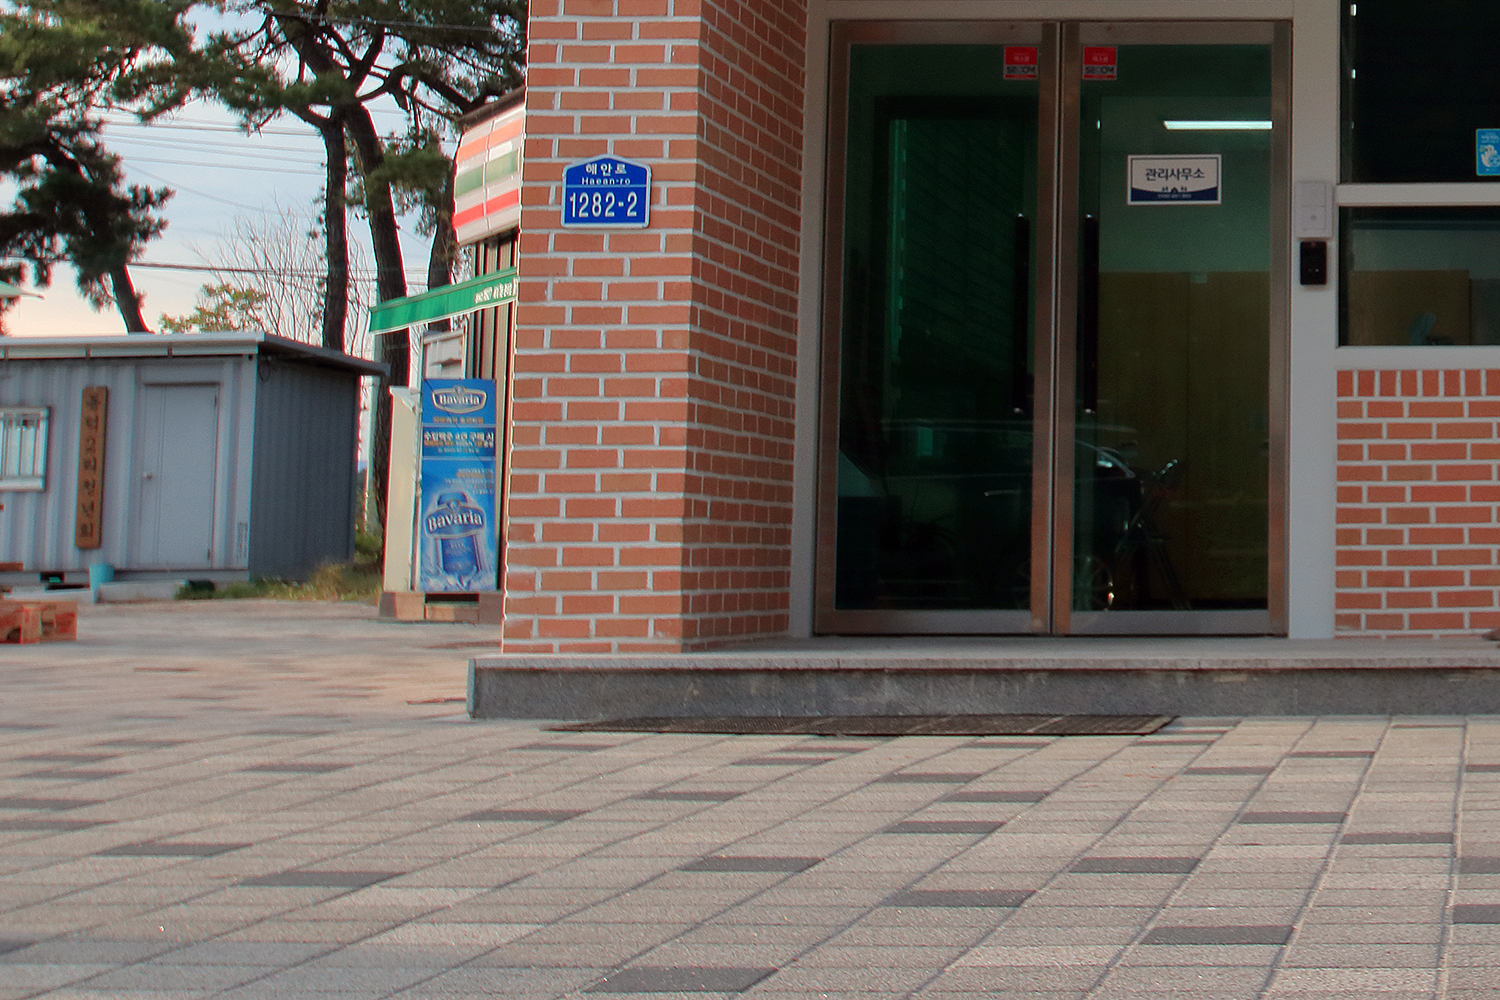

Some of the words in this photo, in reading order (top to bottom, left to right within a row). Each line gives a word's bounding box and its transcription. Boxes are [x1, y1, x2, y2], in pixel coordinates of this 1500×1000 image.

[585, 163, 626, 176] 해안로
[1146, 168, 1204, 181] 관리사무소
[581, 177, 631, 185] Haean-ro
[570, 192, 637, 217] 1282-2
[439, 394, 480, 405] Bavaria
[428, 510, 482, 531] Bavaria
